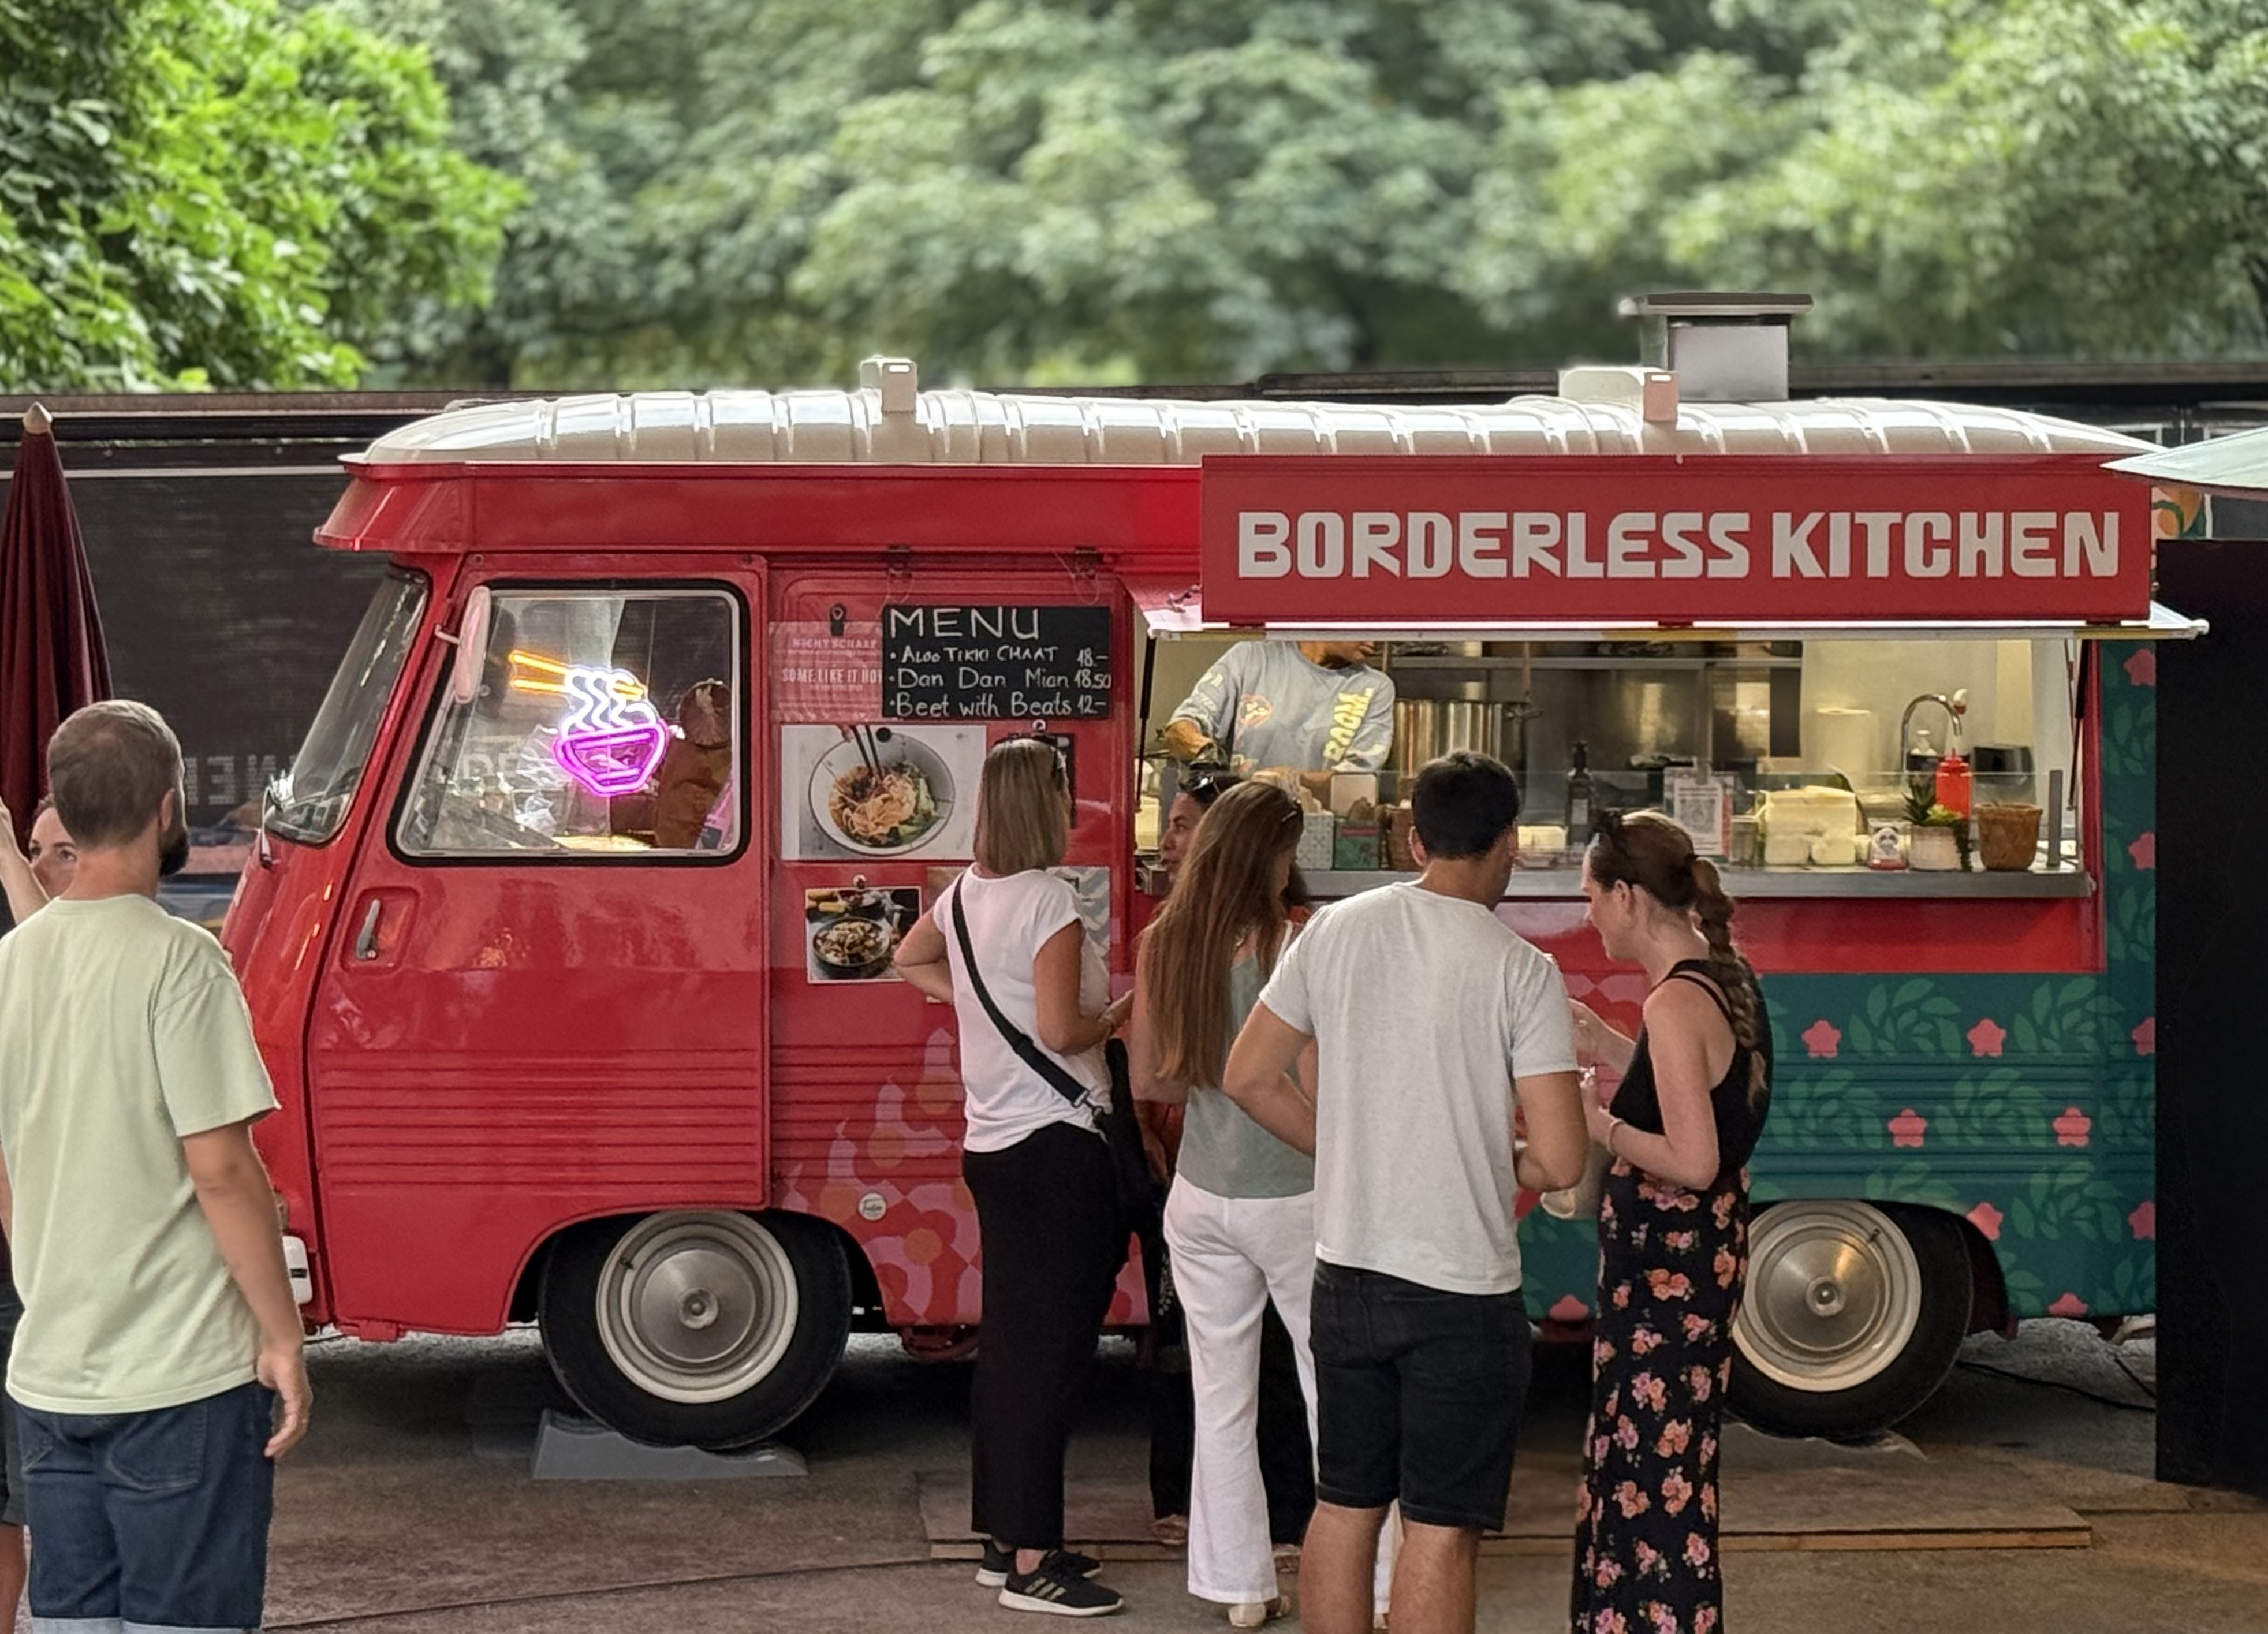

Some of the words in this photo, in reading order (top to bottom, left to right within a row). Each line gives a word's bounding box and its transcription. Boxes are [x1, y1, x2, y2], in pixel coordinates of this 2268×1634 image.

[1238, 512, 1750, 579] BORDERLESS
[1771, 512, 2120, 579] KITCHEN
[889, 607, 1040, 640] MENU
[997, 644, 1060, 662] CHAAT
[782, 667, 814, 684] SOME
[818, 667, 844, 684] LIKE
[846, 667, 859, 684] IT
[898, 667, 944, 689] Dan
[958, 666, 1006, 689] Dan
[1025, 667, 1070, 688] Mian
[896, 692, 950, 718] Beet
[958, 693, 1001, 718] with
[1011, 691, 1072, 717] Beats
